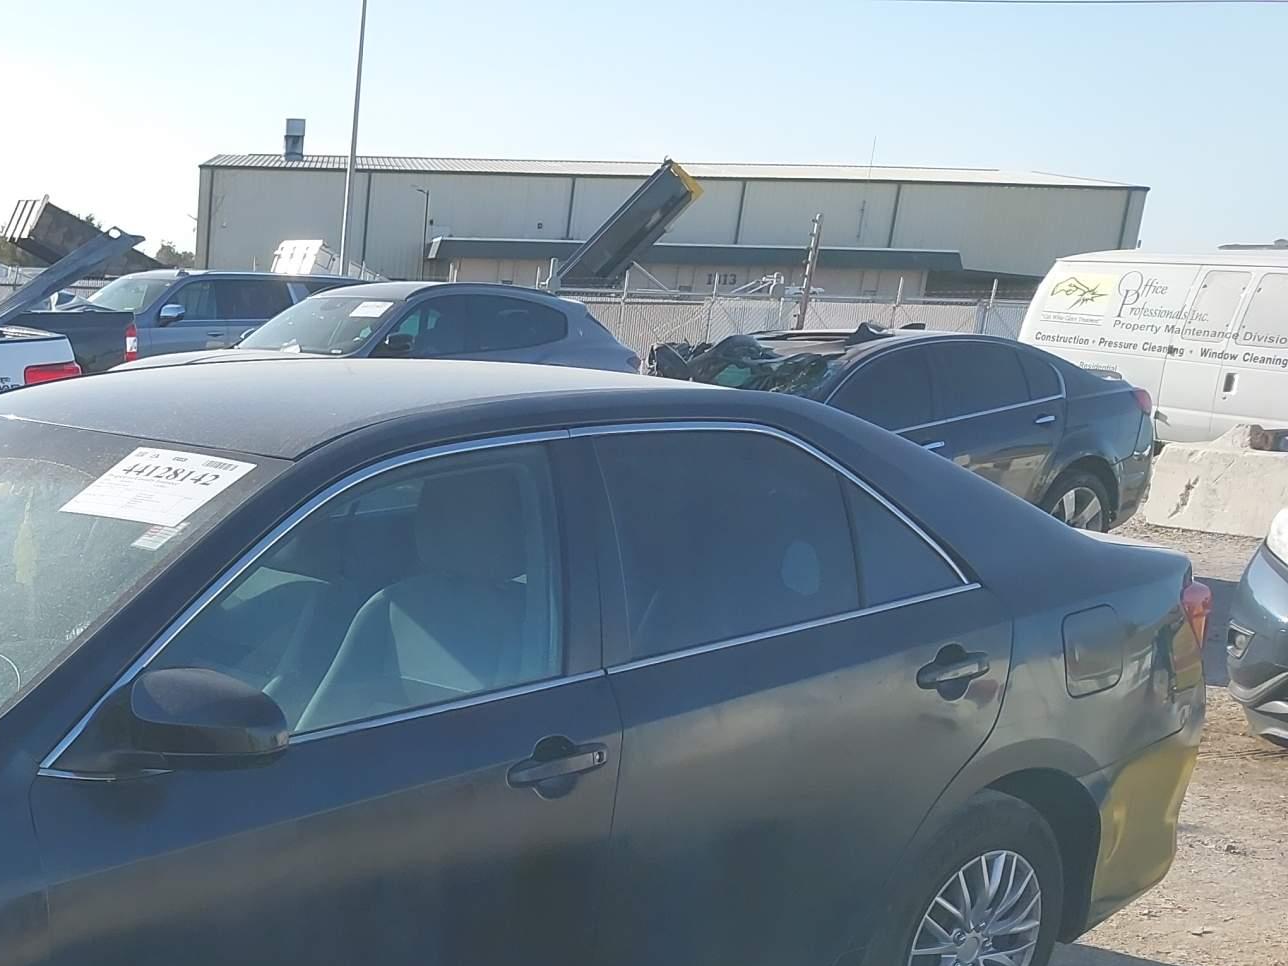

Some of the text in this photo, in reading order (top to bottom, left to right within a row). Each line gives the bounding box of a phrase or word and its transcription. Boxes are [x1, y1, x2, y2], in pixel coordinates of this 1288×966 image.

[1118, 270, 1168, 298] Office
[1116, 289, 1188, 321] Professionals
[1190, 309, 1209, 322] Inc.
[1113, 319, 1161, 335] Property
[1164, 324, 1240, 340] Maintenance
[1035, 331, 1090, 346] Construction
[1098, 337, 1138, 351] Pressure
[1200, 347, 1239, 361] Window
[1242, 352, 1288, 368] Cleaning
[122, 463, 220, 486] 44128142
